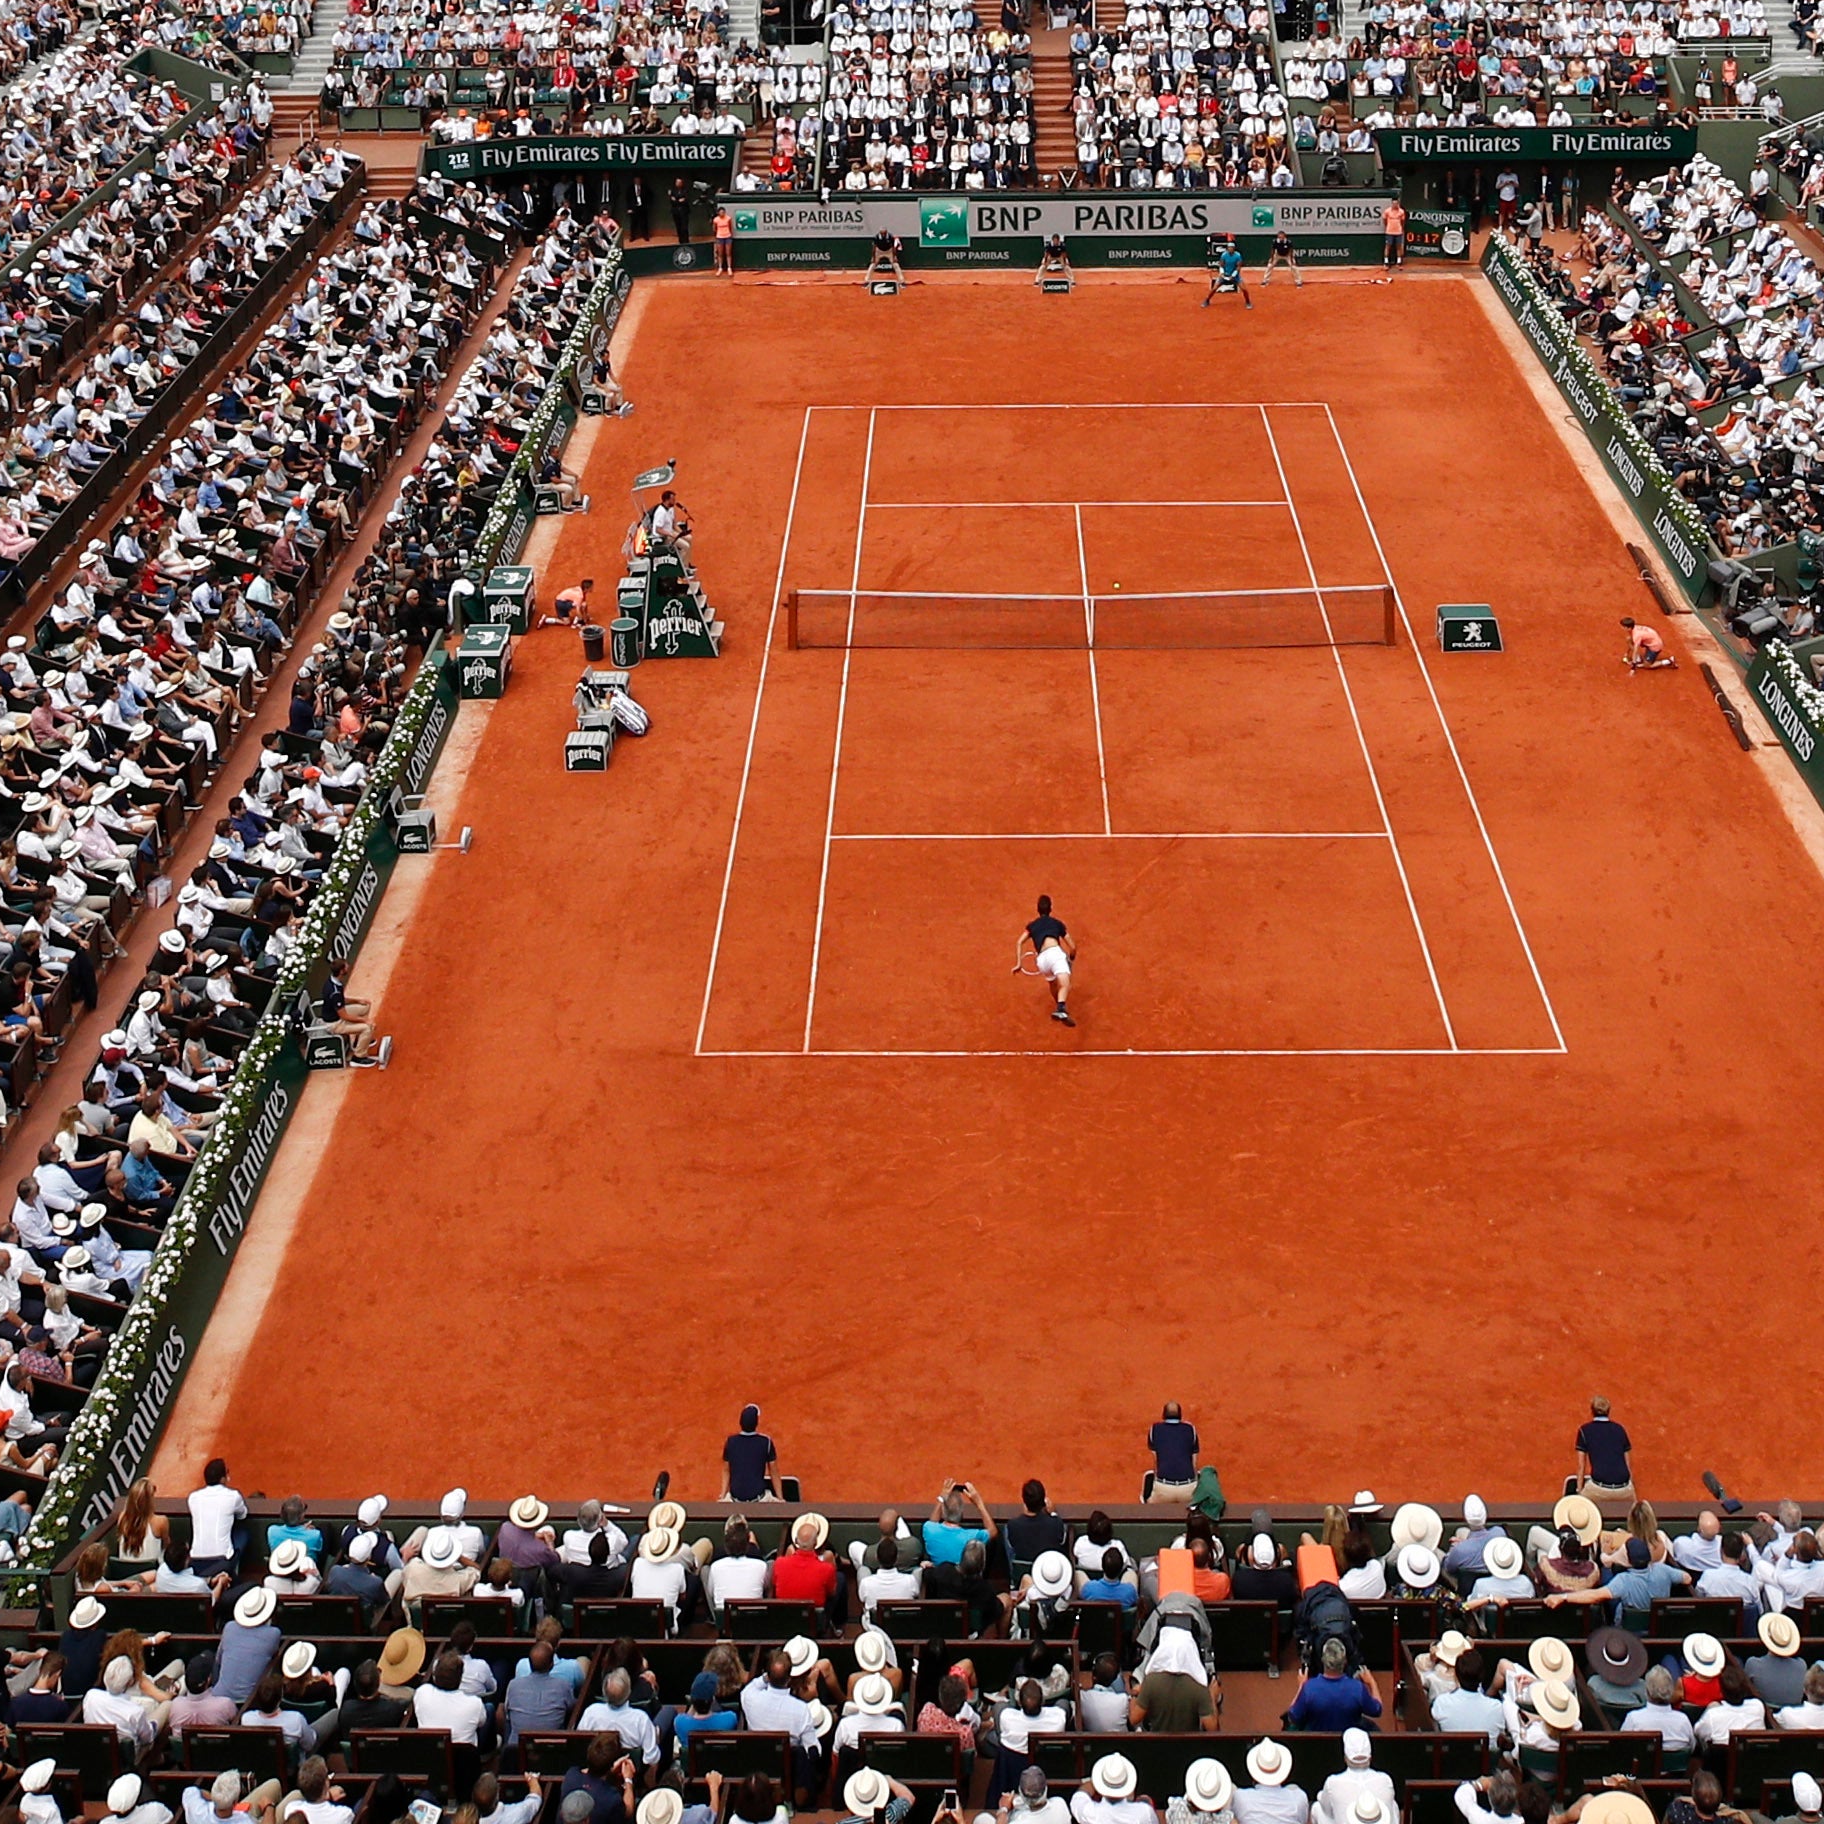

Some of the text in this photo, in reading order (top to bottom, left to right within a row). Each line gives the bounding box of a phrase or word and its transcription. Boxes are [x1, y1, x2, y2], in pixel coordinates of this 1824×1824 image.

[606, 141, 726, 164] Fly Emirates
[1401, 133, 1521, 156] Fly Emirates
[1552, 132, 1672, 154] Fly Emirates
[448, 152, 469, 165] 212
[481, 143, 600, 169] Fly Emirates
[763, 210, 864, 223] BNP PARIBAS
[977, 204, 1209, 232] BNP PARIBAS
[1281, 205, 1382, 219] BNP PARIBAS
[1409, 212, 1465, 223] LONGINES
[1406, 233, 1439, 243] 0:17
[767, 252, 831, 261] BNP PARIBAS
[946, 251, 1010, 260] BNP PARIBAS
[1108, 249, 1172, 259] BNP PARIBAS
[1292, 248, 1350, 257] NP PARIBAS
[1043, 283, 1068, 291] LACOSTE
[1493, 261, 1522, 308] PEUGEOT
[1523, 311, 1558, 363] PEUGEOT
[1561, 365, 1598, 425] PEUGEOT
[1606, 434, 1646, 498] LONGINES
[1652, 507, 1697, 579] LONGINES
[648, 615, 702, 650] perrier
[463, 665, 497, 686] perrier
[1757, 670, 1816, 763] LONGINES
[405, 698, 448, 793] LONGINES
[567, 747, 602, 769] perrier
[309, 1058, 342, 1066] LACOSTE
[208, 1079, 289, 1256] Fly Emirates
[109, 1324, 185, 1490] Emirates
